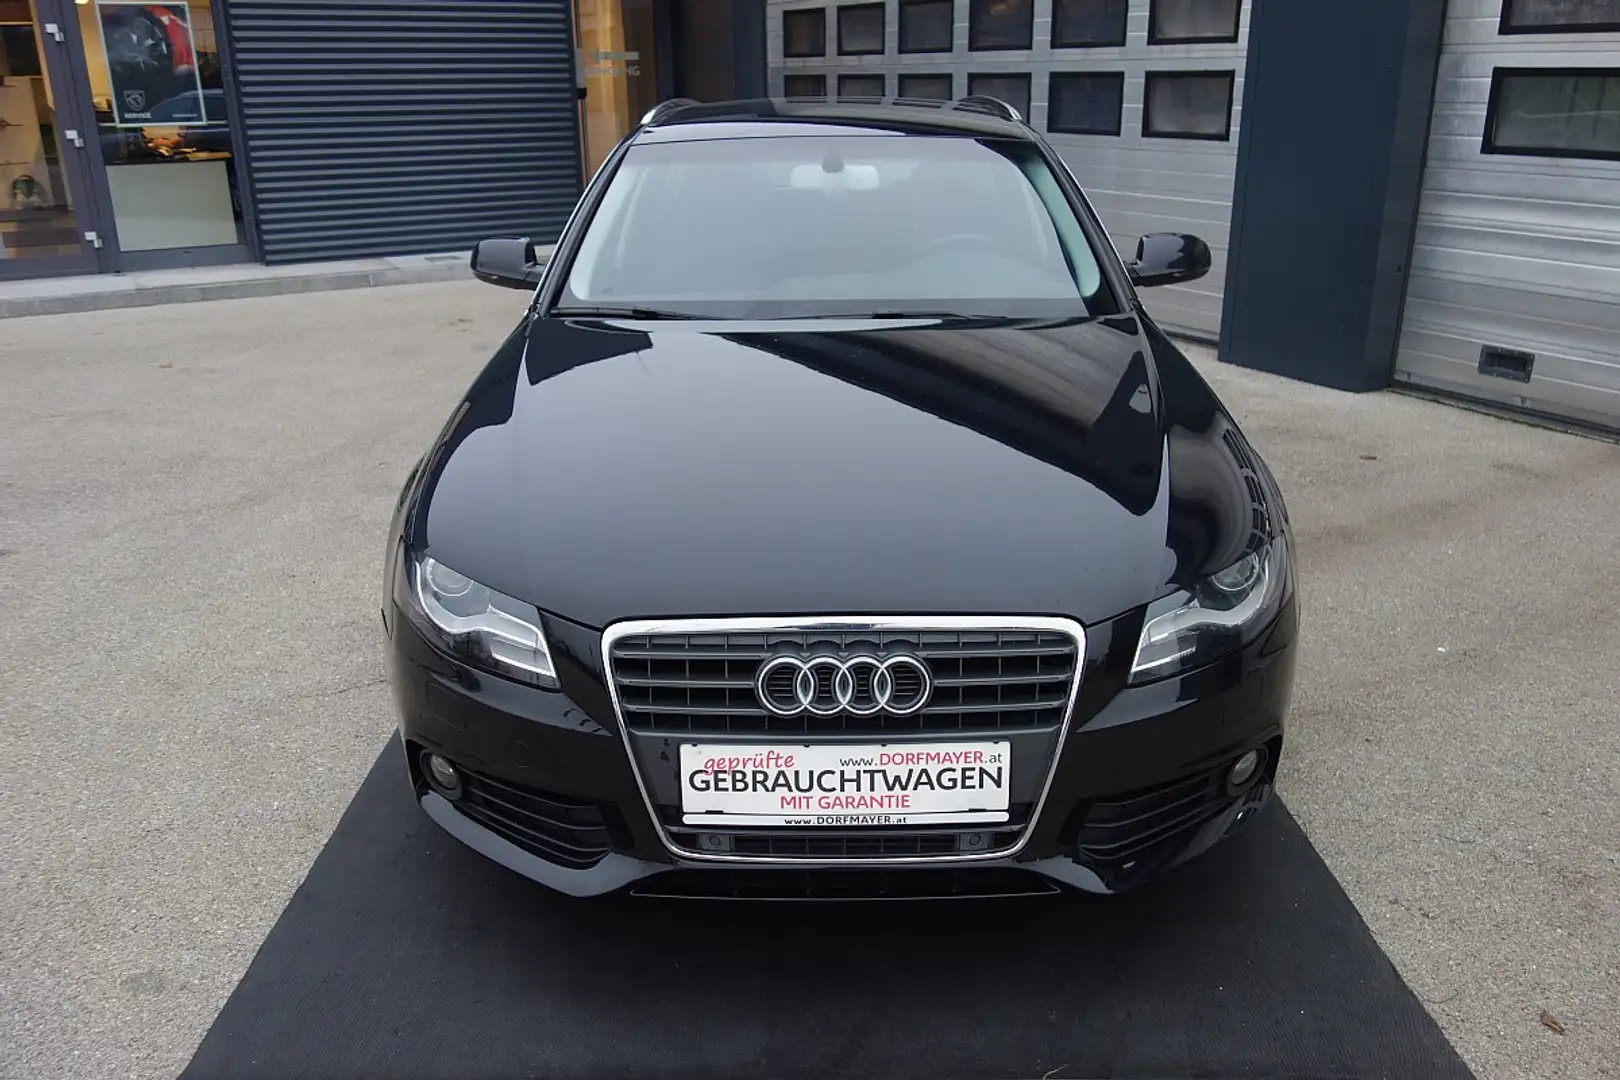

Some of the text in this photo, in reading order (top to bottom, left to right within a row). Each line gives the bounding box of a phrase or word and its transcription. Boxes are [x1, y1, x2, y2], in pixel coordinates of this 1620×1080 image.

[703, 750, 795, 776] geprüfte
[839, 751, 1003, 767] www.DORFMAYER.at
[688, 766, 1003, 793] GEBRAUCHTWAGEN
[780, 794, 911, 810] MIT GARANTIE
[784, 815, 907, 825] www.DORFMAYER.at
